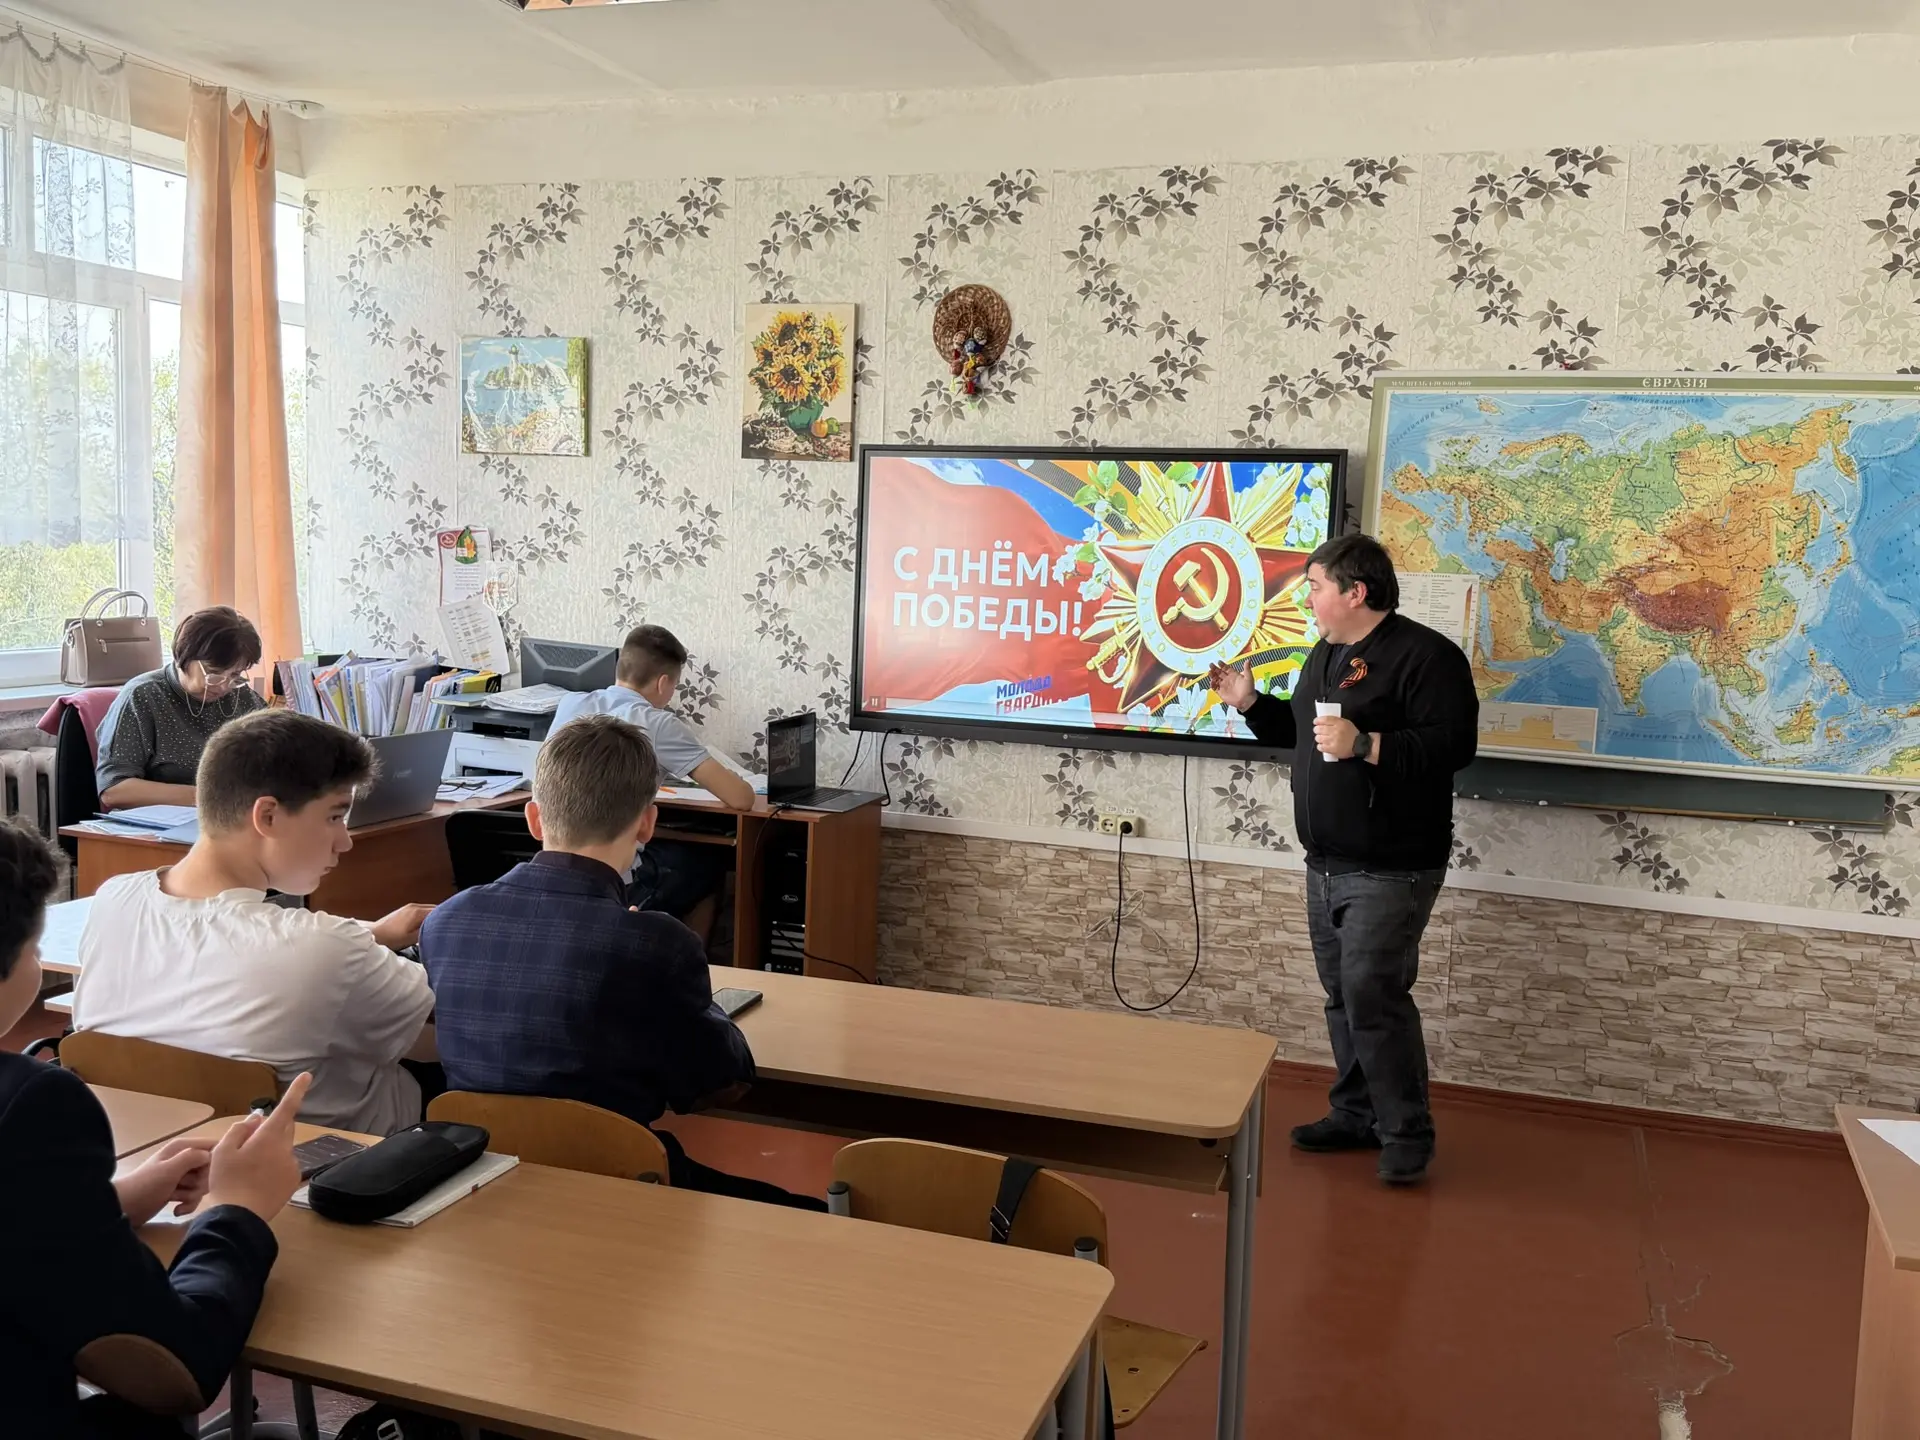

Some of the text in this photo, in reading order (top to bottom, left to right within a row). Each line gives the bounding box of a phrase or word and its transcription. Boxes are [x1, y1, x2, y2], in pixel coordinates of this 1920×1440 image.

[1642, 378, 1708, 388] ЄВРАЗІЯ
[893, 540, 1049, 591] С ДНЁМ
[893, 592, 1082, 641] ПОБЕДЫ!
